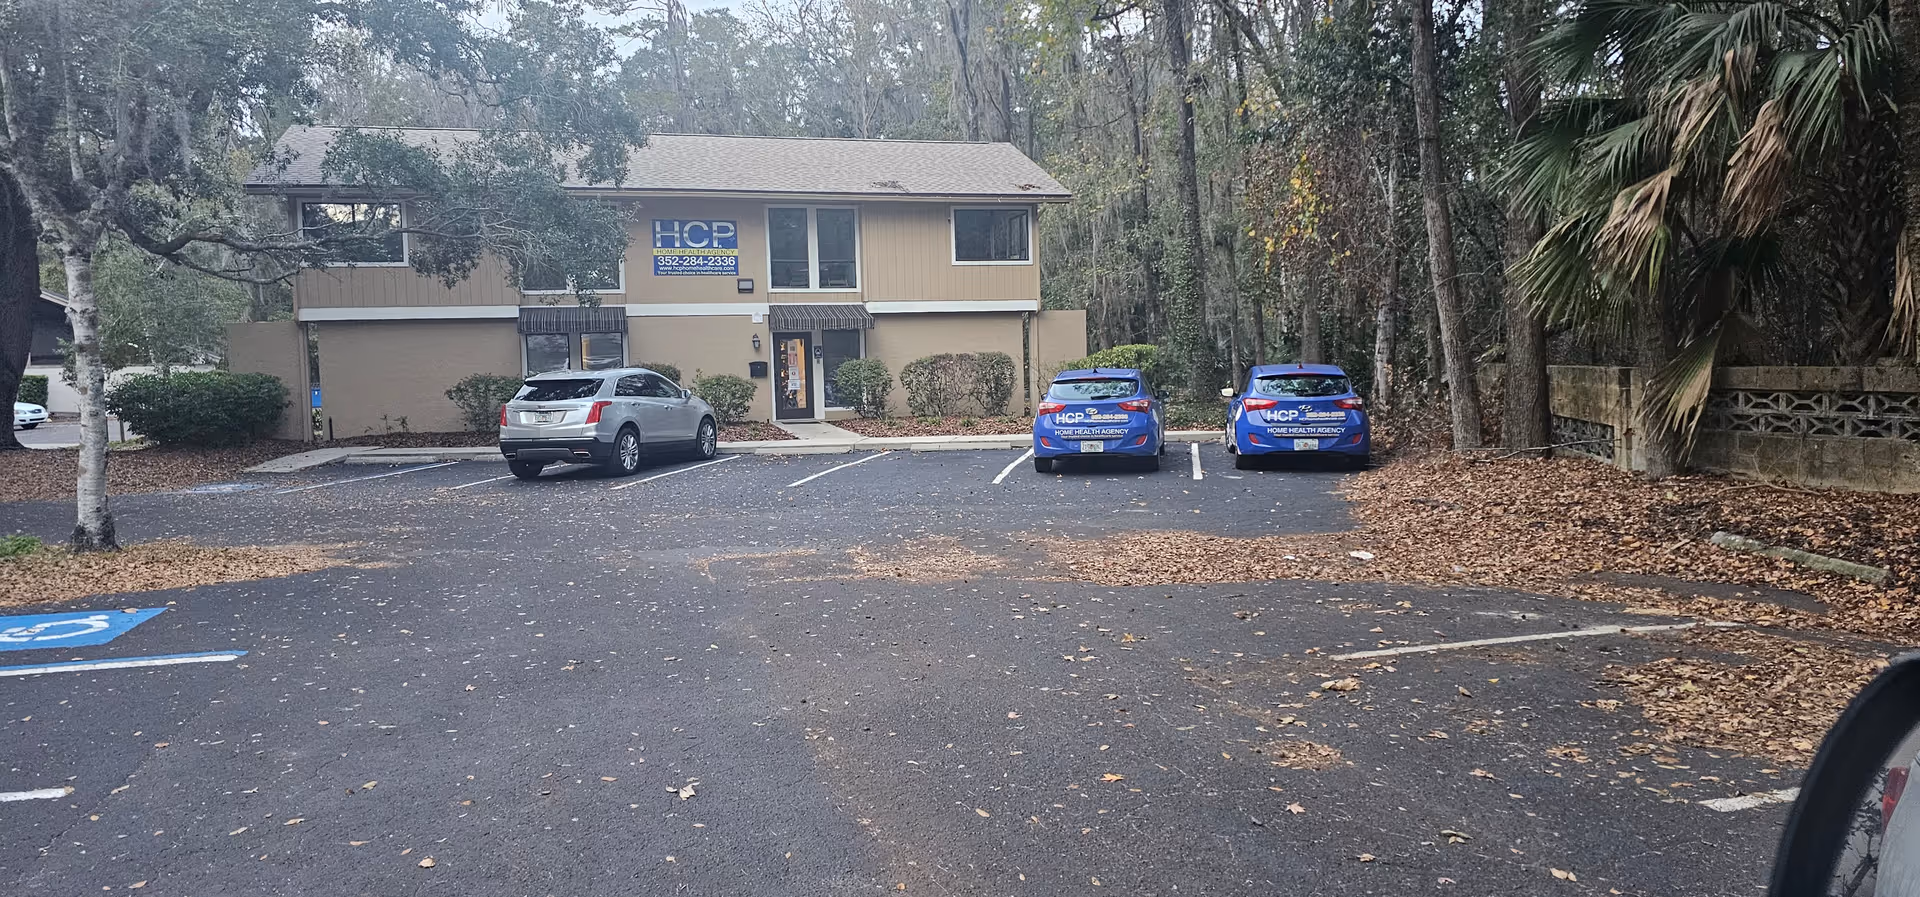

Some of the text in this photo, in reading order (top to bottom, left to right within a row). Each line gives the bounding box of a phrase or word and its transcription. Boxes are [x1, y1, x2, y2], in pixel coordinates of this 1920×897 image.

[655, 220, 735, 248] HCP
[657, 256, 736, 266] 352-284-2336
[1056, 412, 1084, 424] HCP
[1267, 410, 1299, 421] HCP
